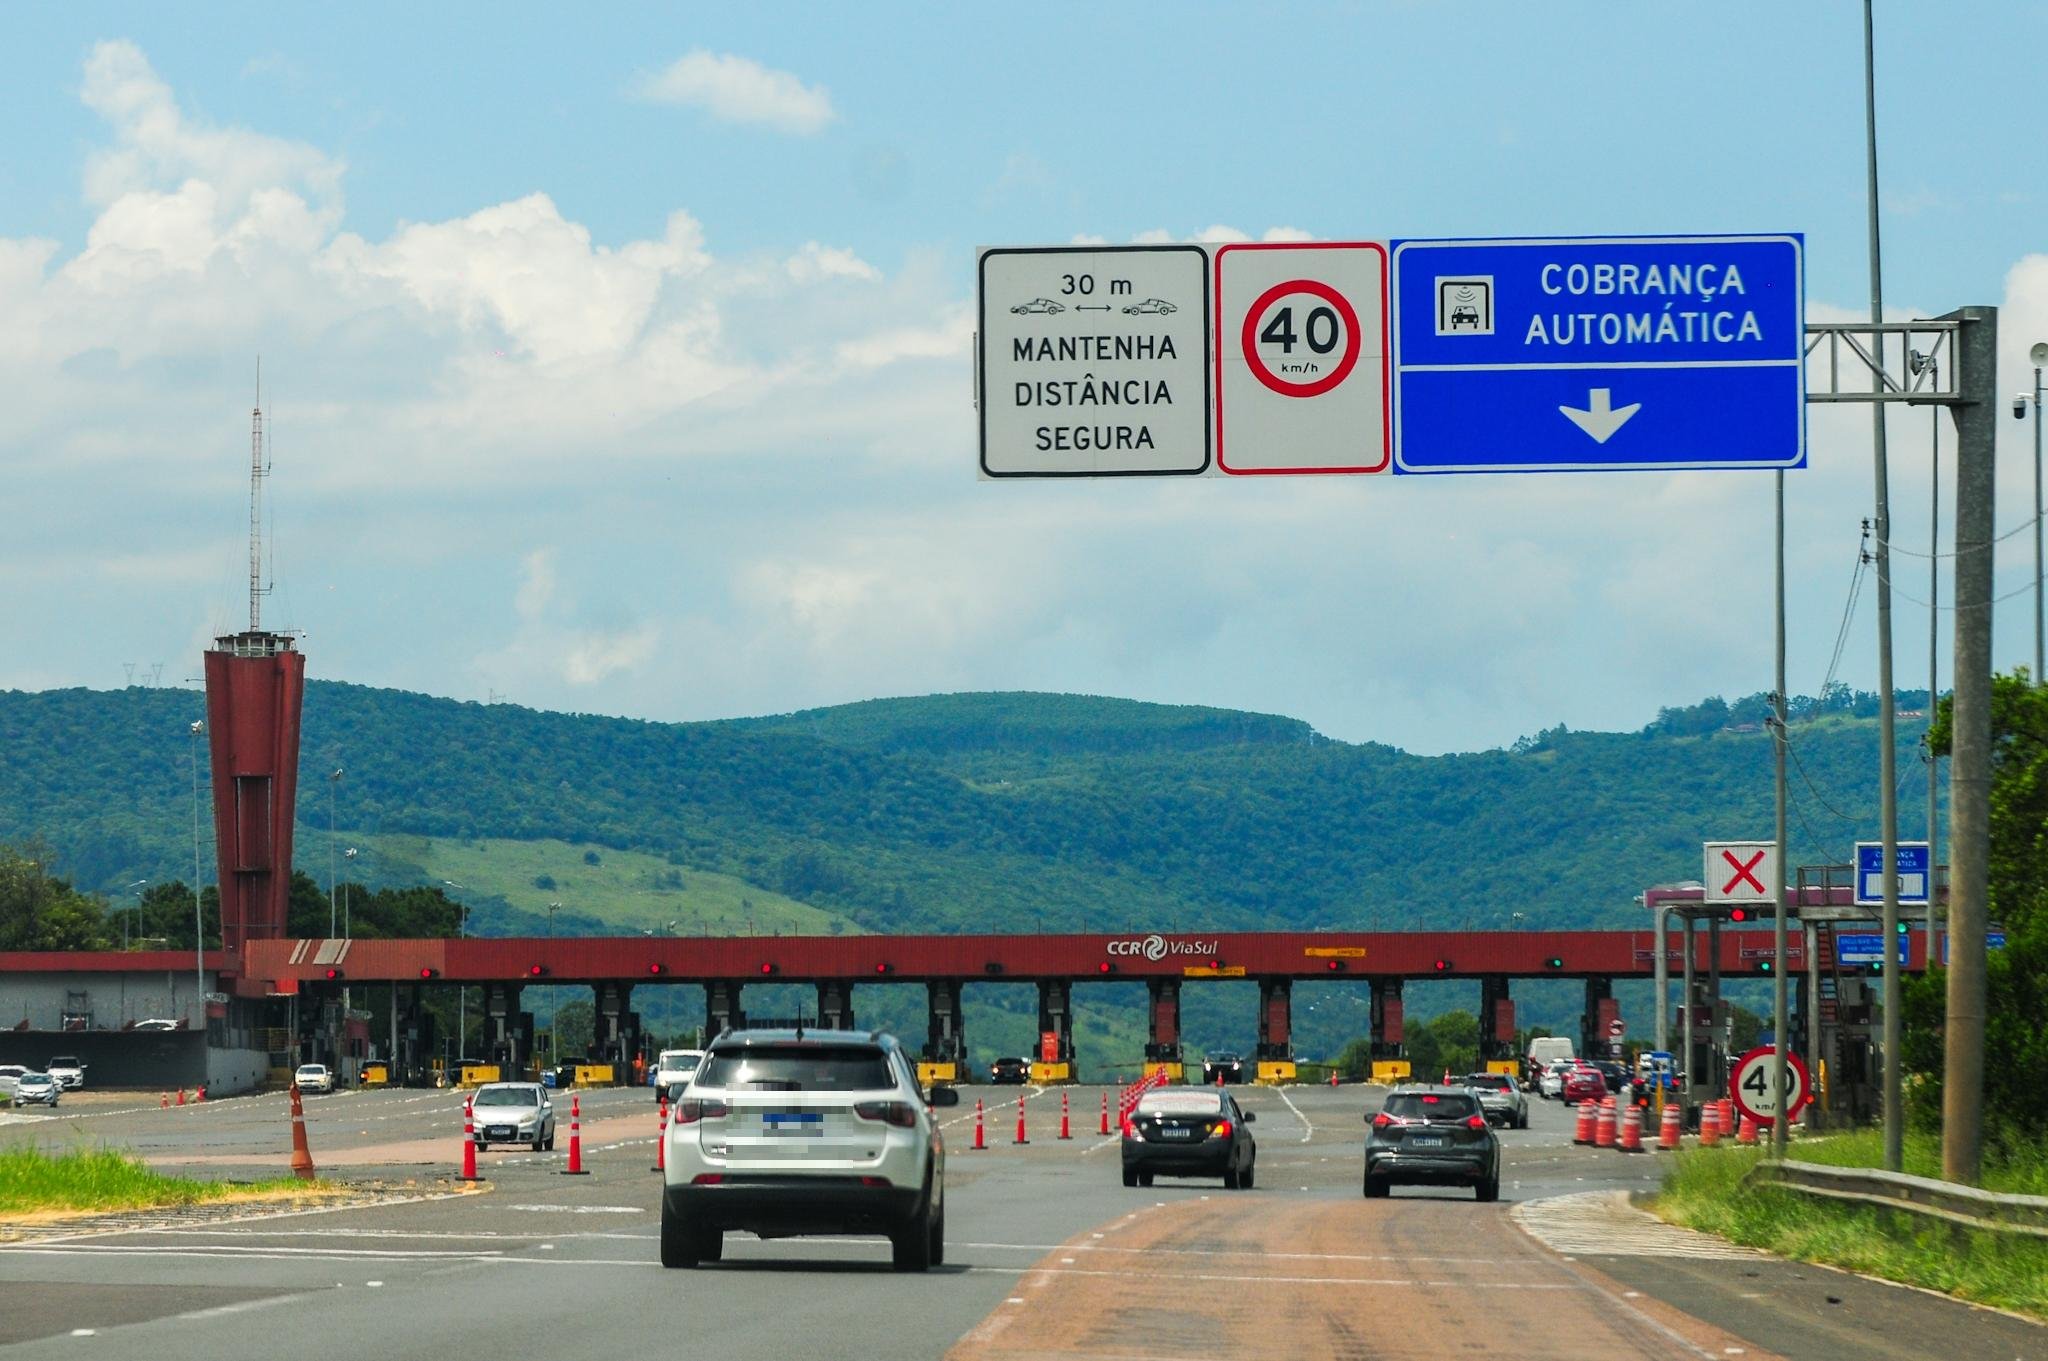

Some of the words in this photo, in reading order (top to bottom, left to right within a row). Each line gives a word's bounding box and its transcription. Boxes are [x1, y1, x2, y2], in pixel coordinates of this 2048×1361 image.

[1061, 274, 1095, 295] 30
[1110, 279, 1132, 295] m
[1541, 263, 1746, 303] COBRANÇA
[1260, 307, 1340, 354] 40
[1524, 302, 1763, 345] AUTOMÁTICA
[1012, 335, 1178, 362] MANTENHA
[1281, 362, 1319, 374] km/h
[1015, 373, 1173, 407] DISTÂNCIA
[1035, 425, 1156, 451] SEGURA
[1106, 941, 1142, 955] CCR
[1170, 940, 1218, 955] ViaSul
[1755, 1102, 1777, 1111] km/
